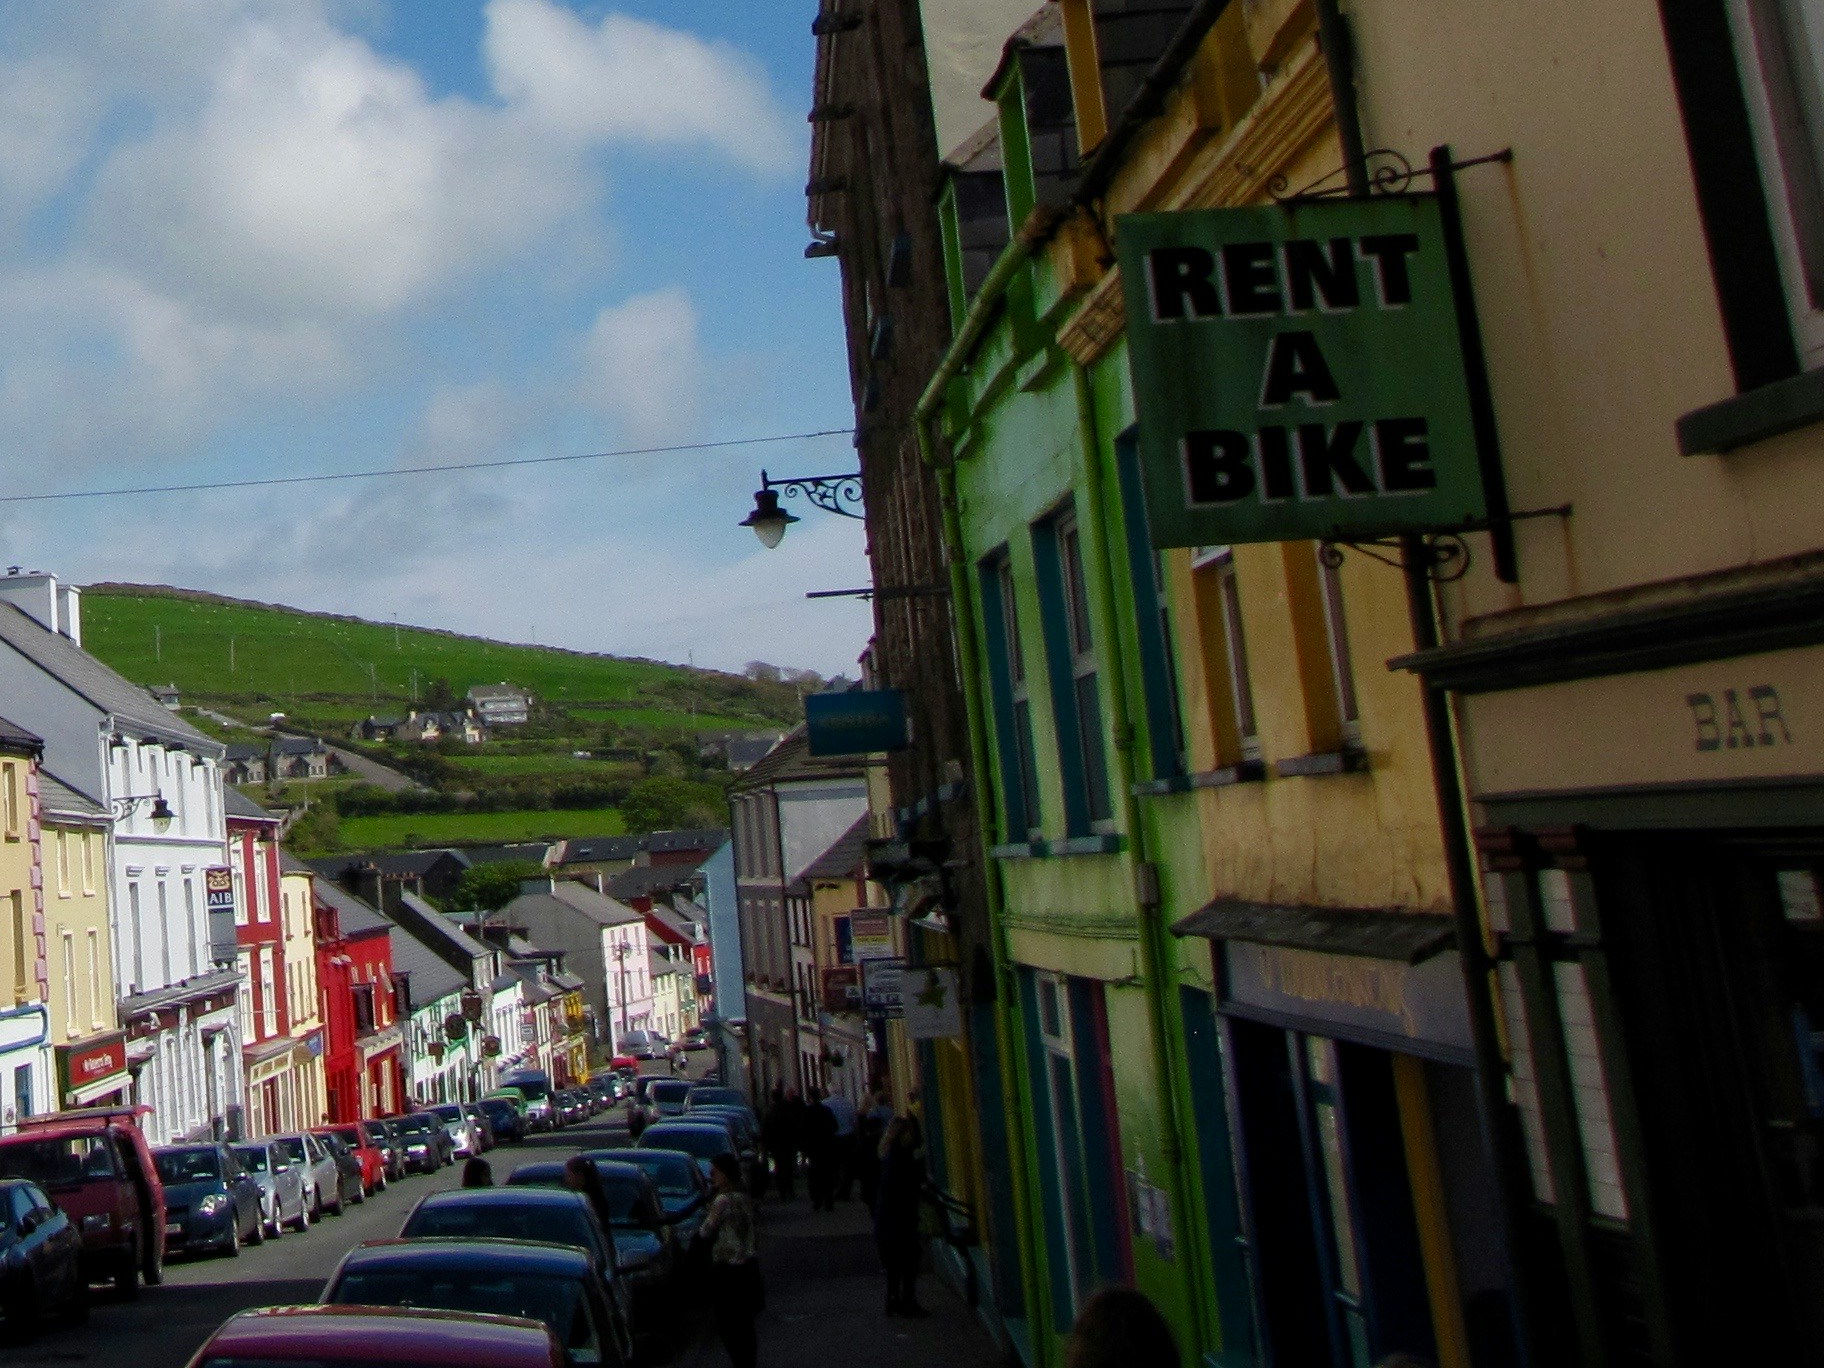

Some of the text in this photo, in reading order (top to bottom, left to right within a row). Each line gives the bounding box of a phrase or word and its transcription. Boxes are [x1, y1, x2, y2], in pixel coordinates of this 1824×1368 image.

[1144, 233, 1420, 324] RENT
[1258, 332, 1341, 410] A
[1178, 417, 1437, 510] BIKE
[1685, 684, 1794, 752] BAR
[210, 892, 233, 905] AIB
